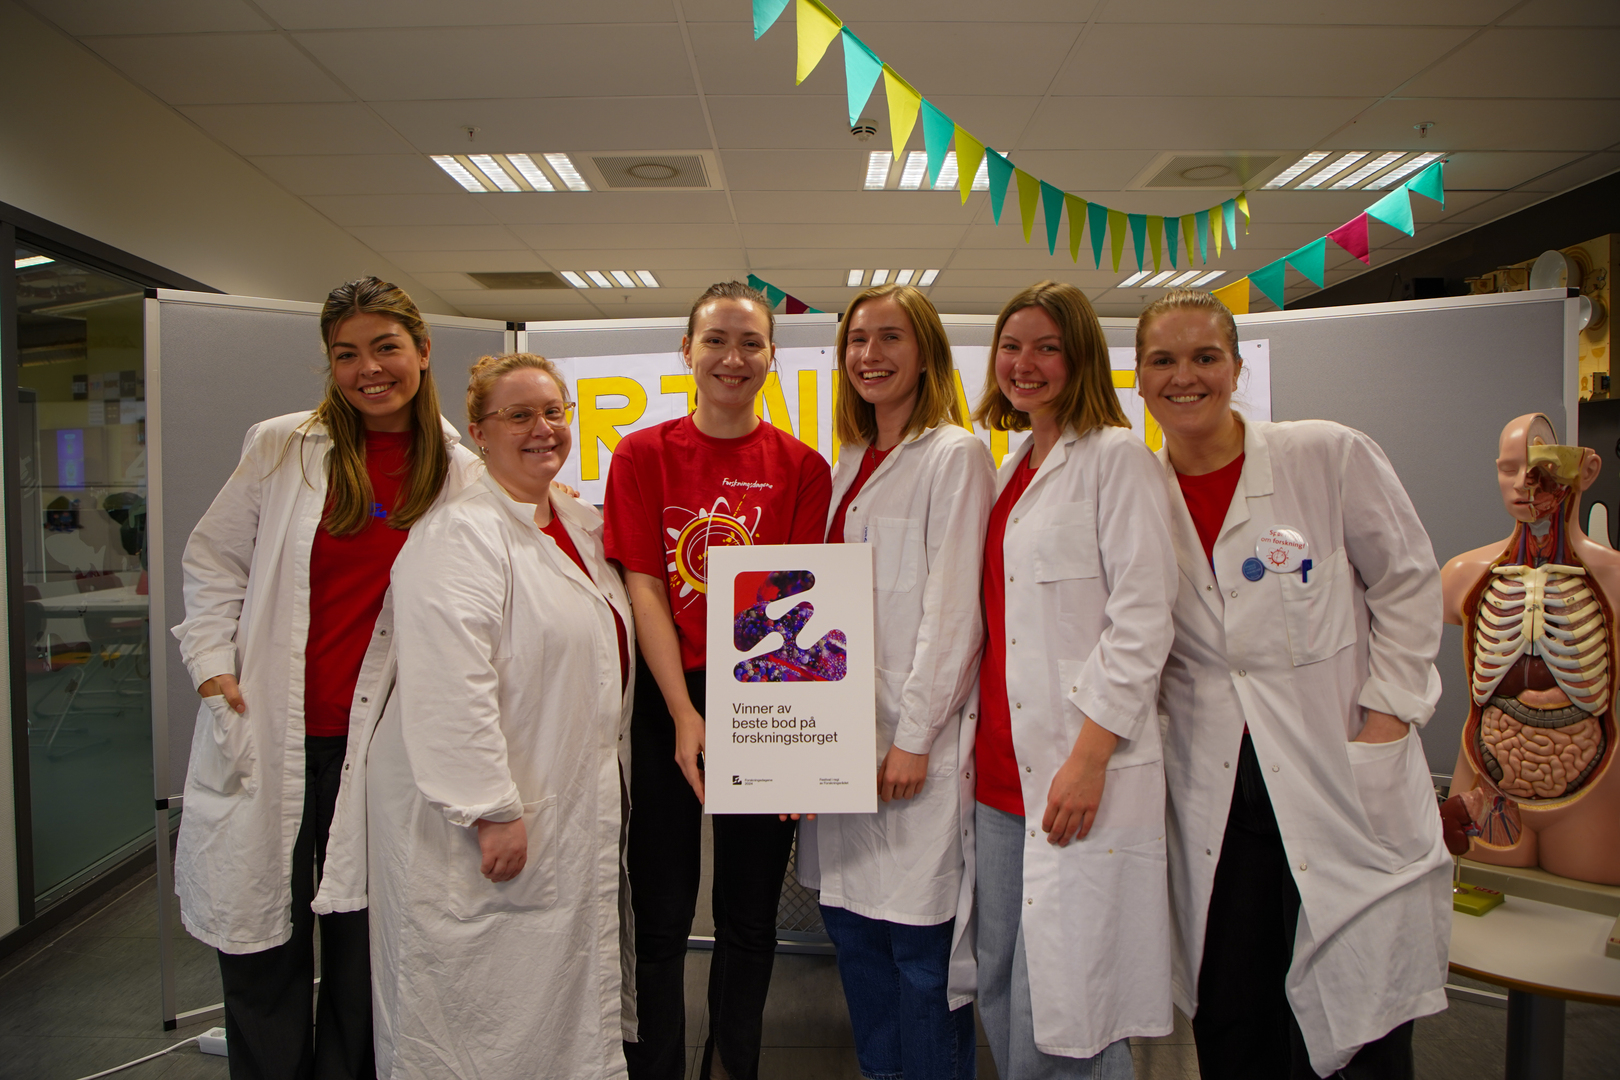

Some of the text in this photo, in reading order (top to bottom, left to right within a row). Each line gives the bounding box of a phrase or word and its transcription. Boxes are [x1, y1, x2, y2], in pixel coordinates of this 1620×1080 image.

[732, 702, 792, 714] Vinner av
[732, 716, 816, 731] beste bod på
[732, 731, 838, 746] forskningstorget
